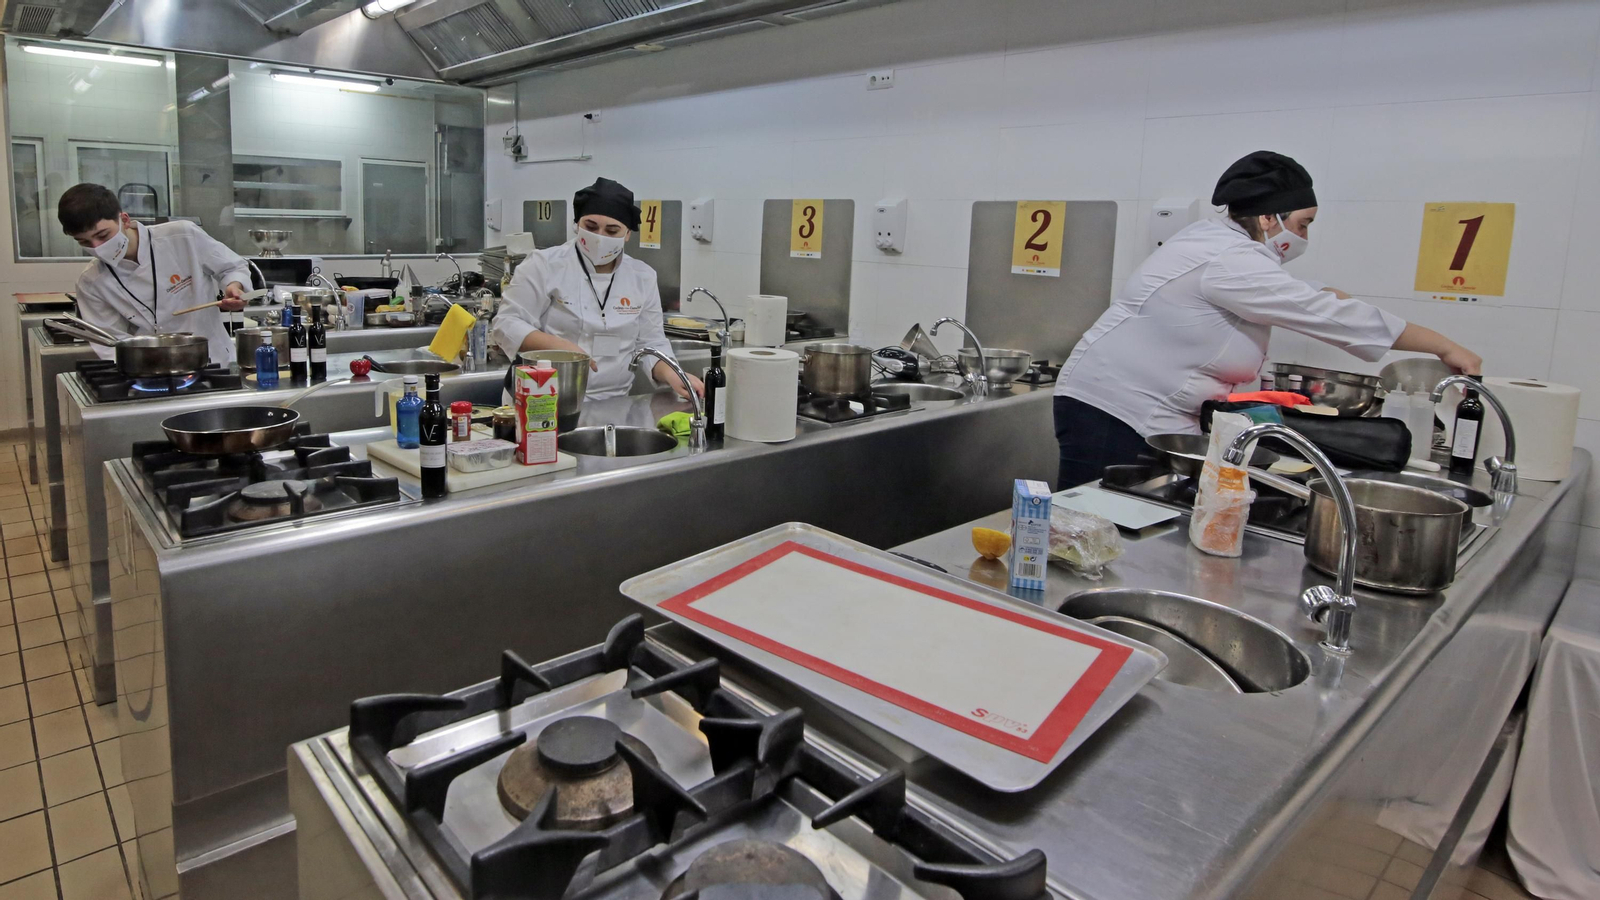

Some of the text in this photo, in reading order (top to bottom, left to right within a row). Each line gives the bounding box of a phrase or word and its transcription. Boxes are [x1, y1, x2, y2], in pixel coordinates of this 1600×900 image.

[538, 201, 552, 220] 10
[645, 205, 657, 233] 4
[798, 205, 817, 239] 3
[1024, 209, 1052, 252] 2
[1448, 214, 1485, 271] 1
